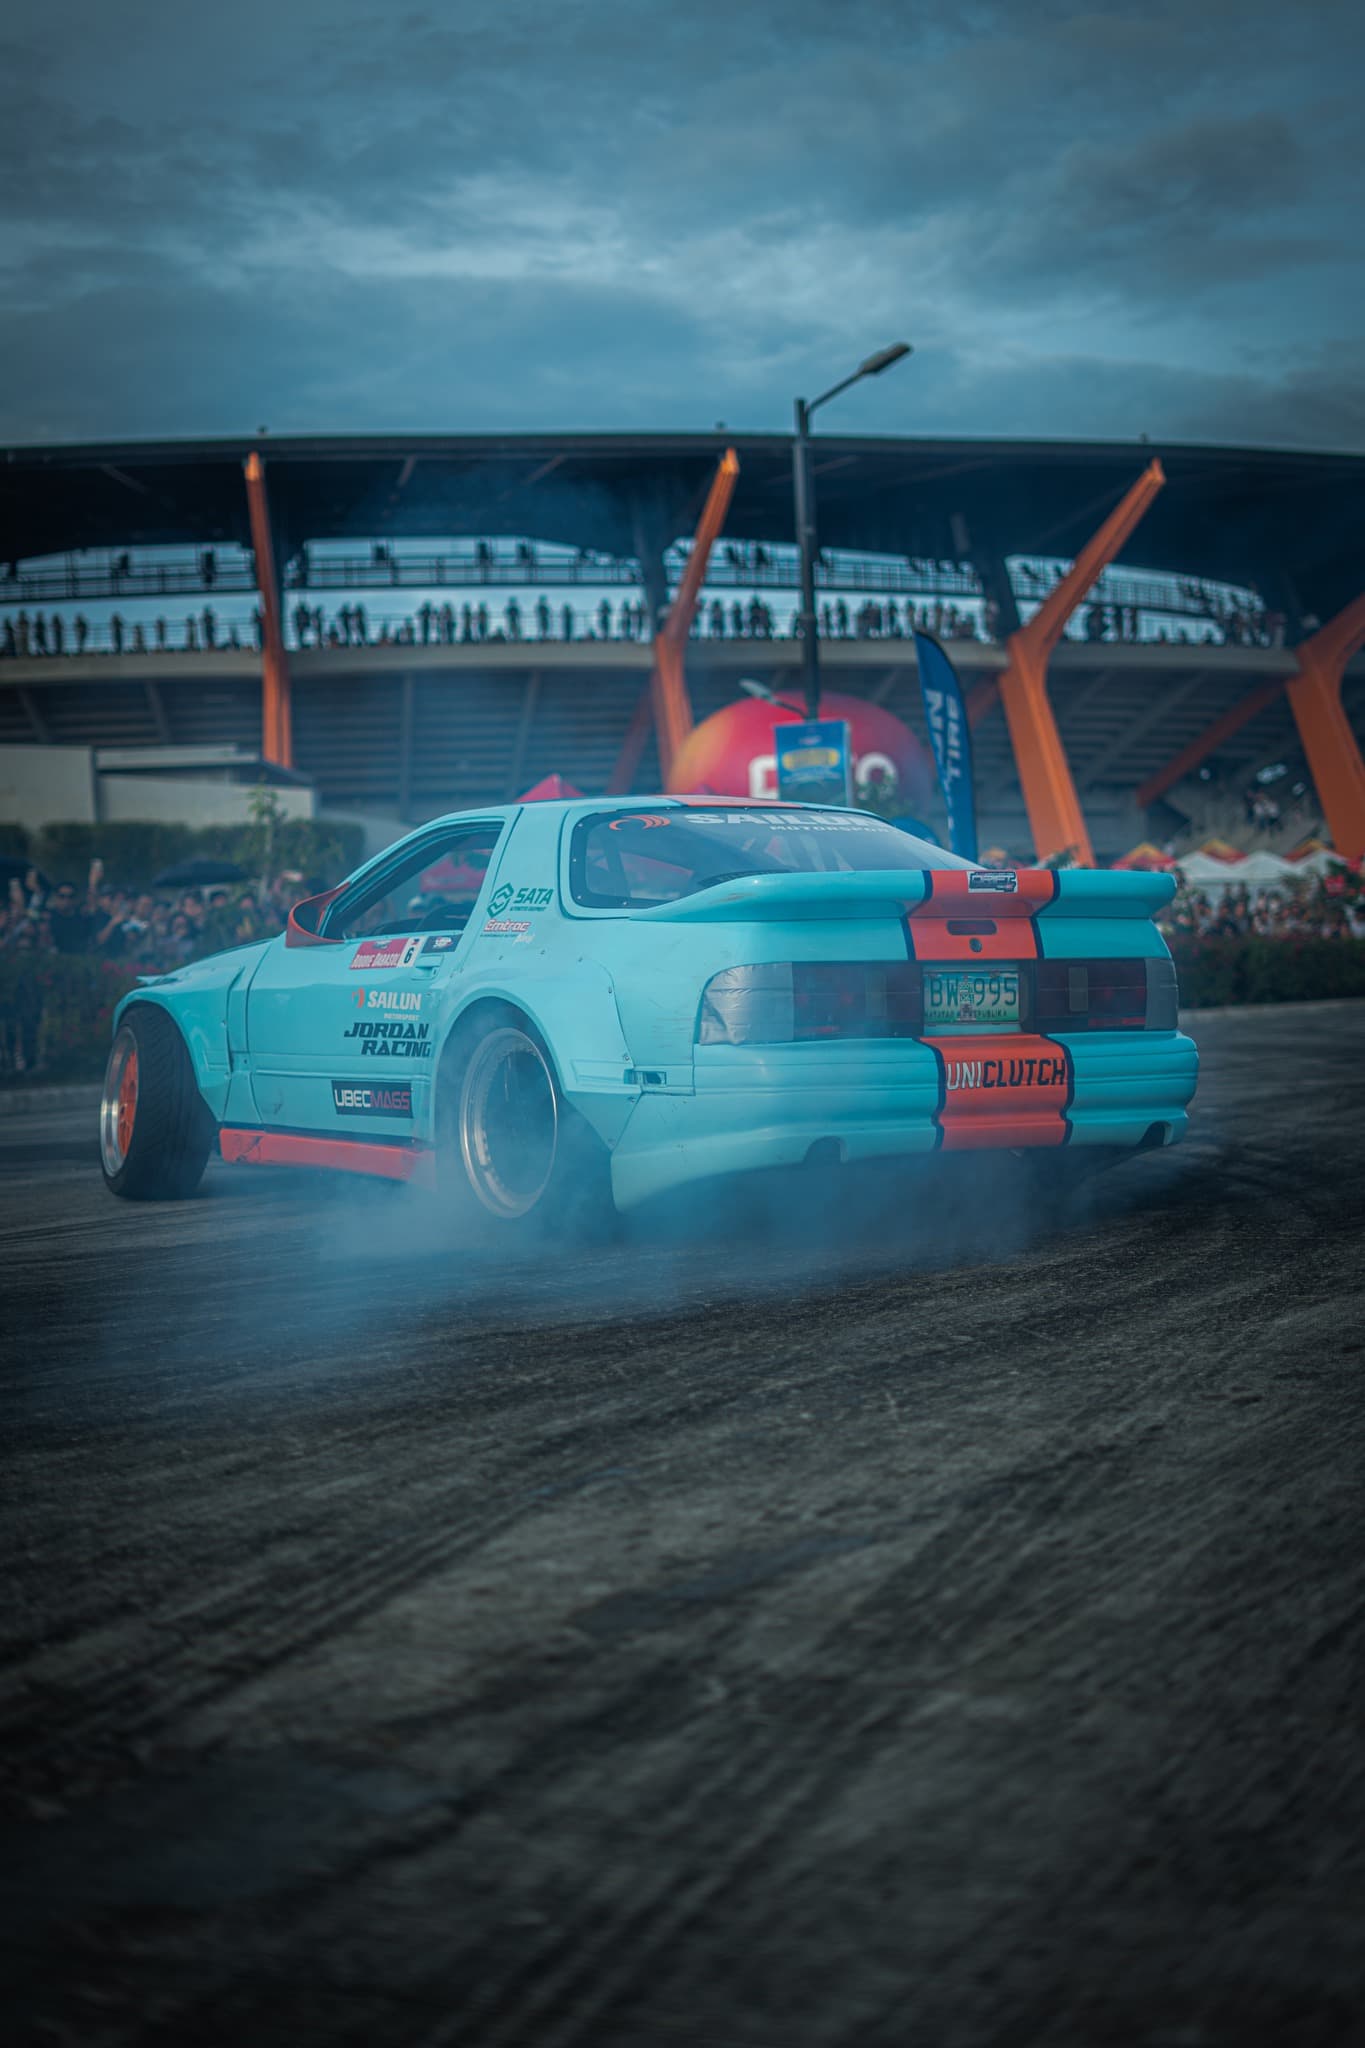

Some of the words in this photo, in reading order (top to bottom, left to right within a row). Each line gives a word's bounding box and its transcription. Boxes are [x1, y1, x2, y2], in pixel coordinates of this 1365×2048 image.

[512, 888, 554, 904] SATA
[403, 947, 414, 964] 6
[973, 976, 1017, 1007] 995
[367, 990, 422, 1011] SAILUN
[343, 1022, 430, 1039] JORDAN
[360, 1040, 432, 1057] RACING
[946, 1058, 1066, 1091] UNICLUTCH
